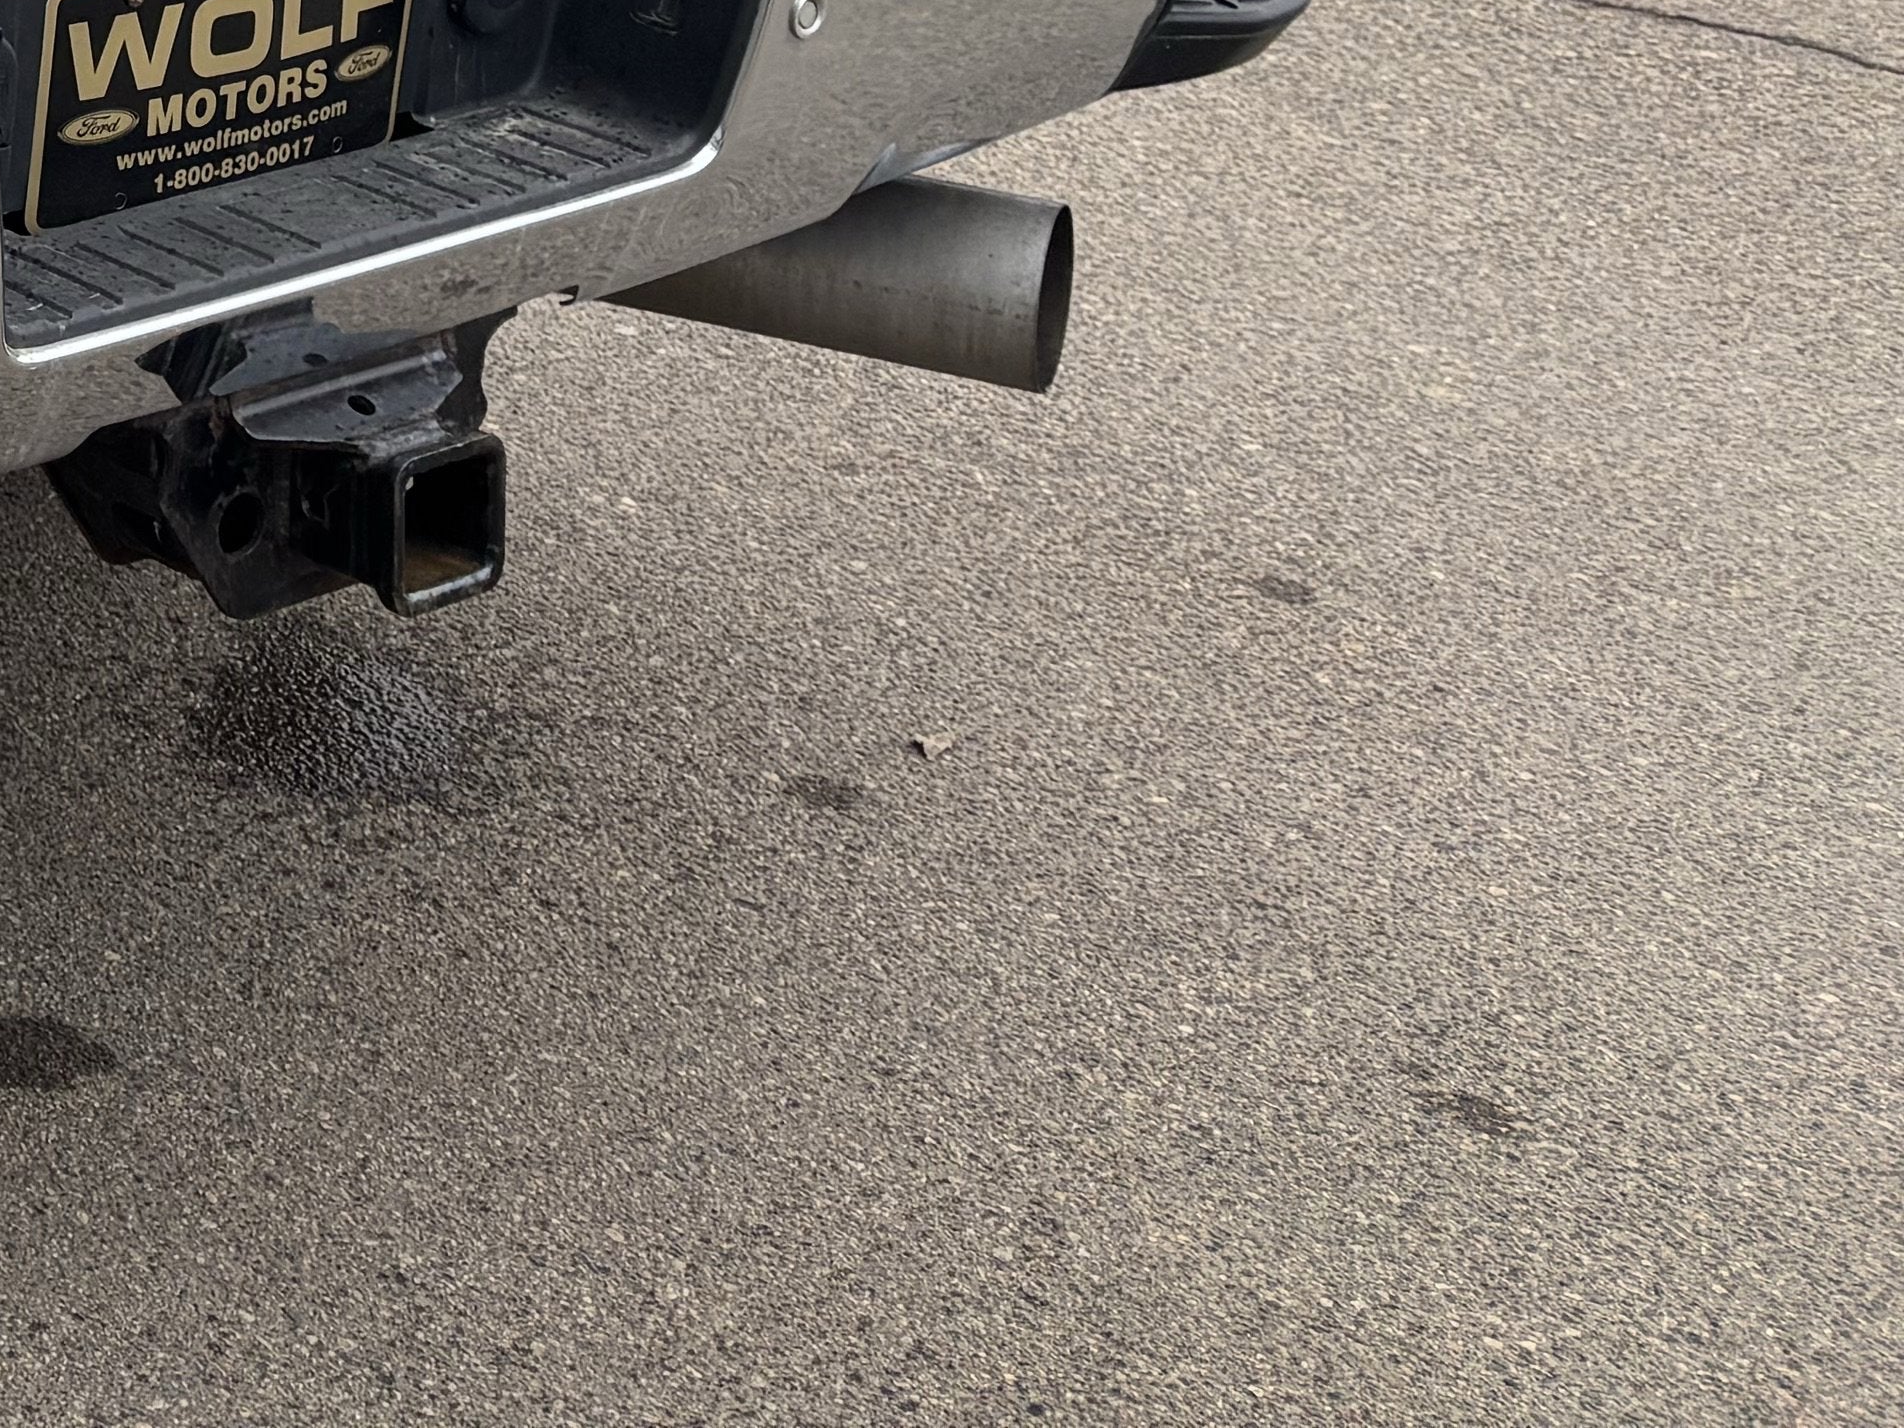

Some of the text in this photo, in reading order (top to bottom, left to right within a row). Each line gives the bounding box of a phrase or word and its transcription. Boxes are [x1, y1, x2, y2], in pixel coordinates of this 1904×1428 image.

[116, 97, 348, 172] www.wolfmotors.com
[147, 59, 328, 138] MOTORS
[153, 135, 315, 194] 1-800-830-0017
